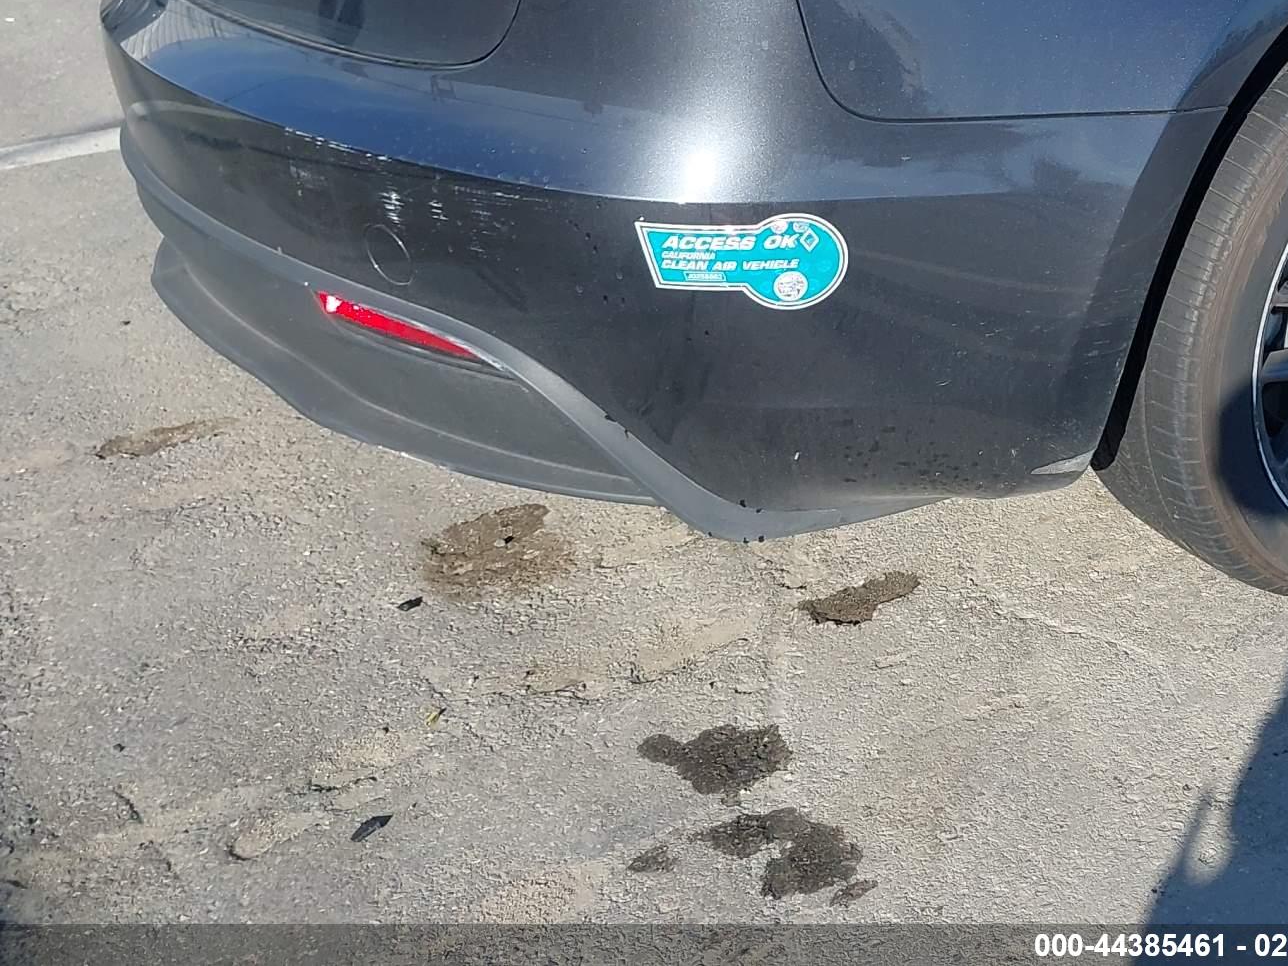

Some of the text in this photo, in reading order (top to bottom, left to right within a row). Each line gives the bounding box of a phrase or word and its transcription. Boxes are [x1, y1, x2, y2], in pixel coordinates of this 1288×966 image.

[662, 234, 799, 251] ACCESS OK
[661, 250, 716, 260] CALIFORNIA
[661, 259, 800, 271] CLEAN AIR VEHICLE
